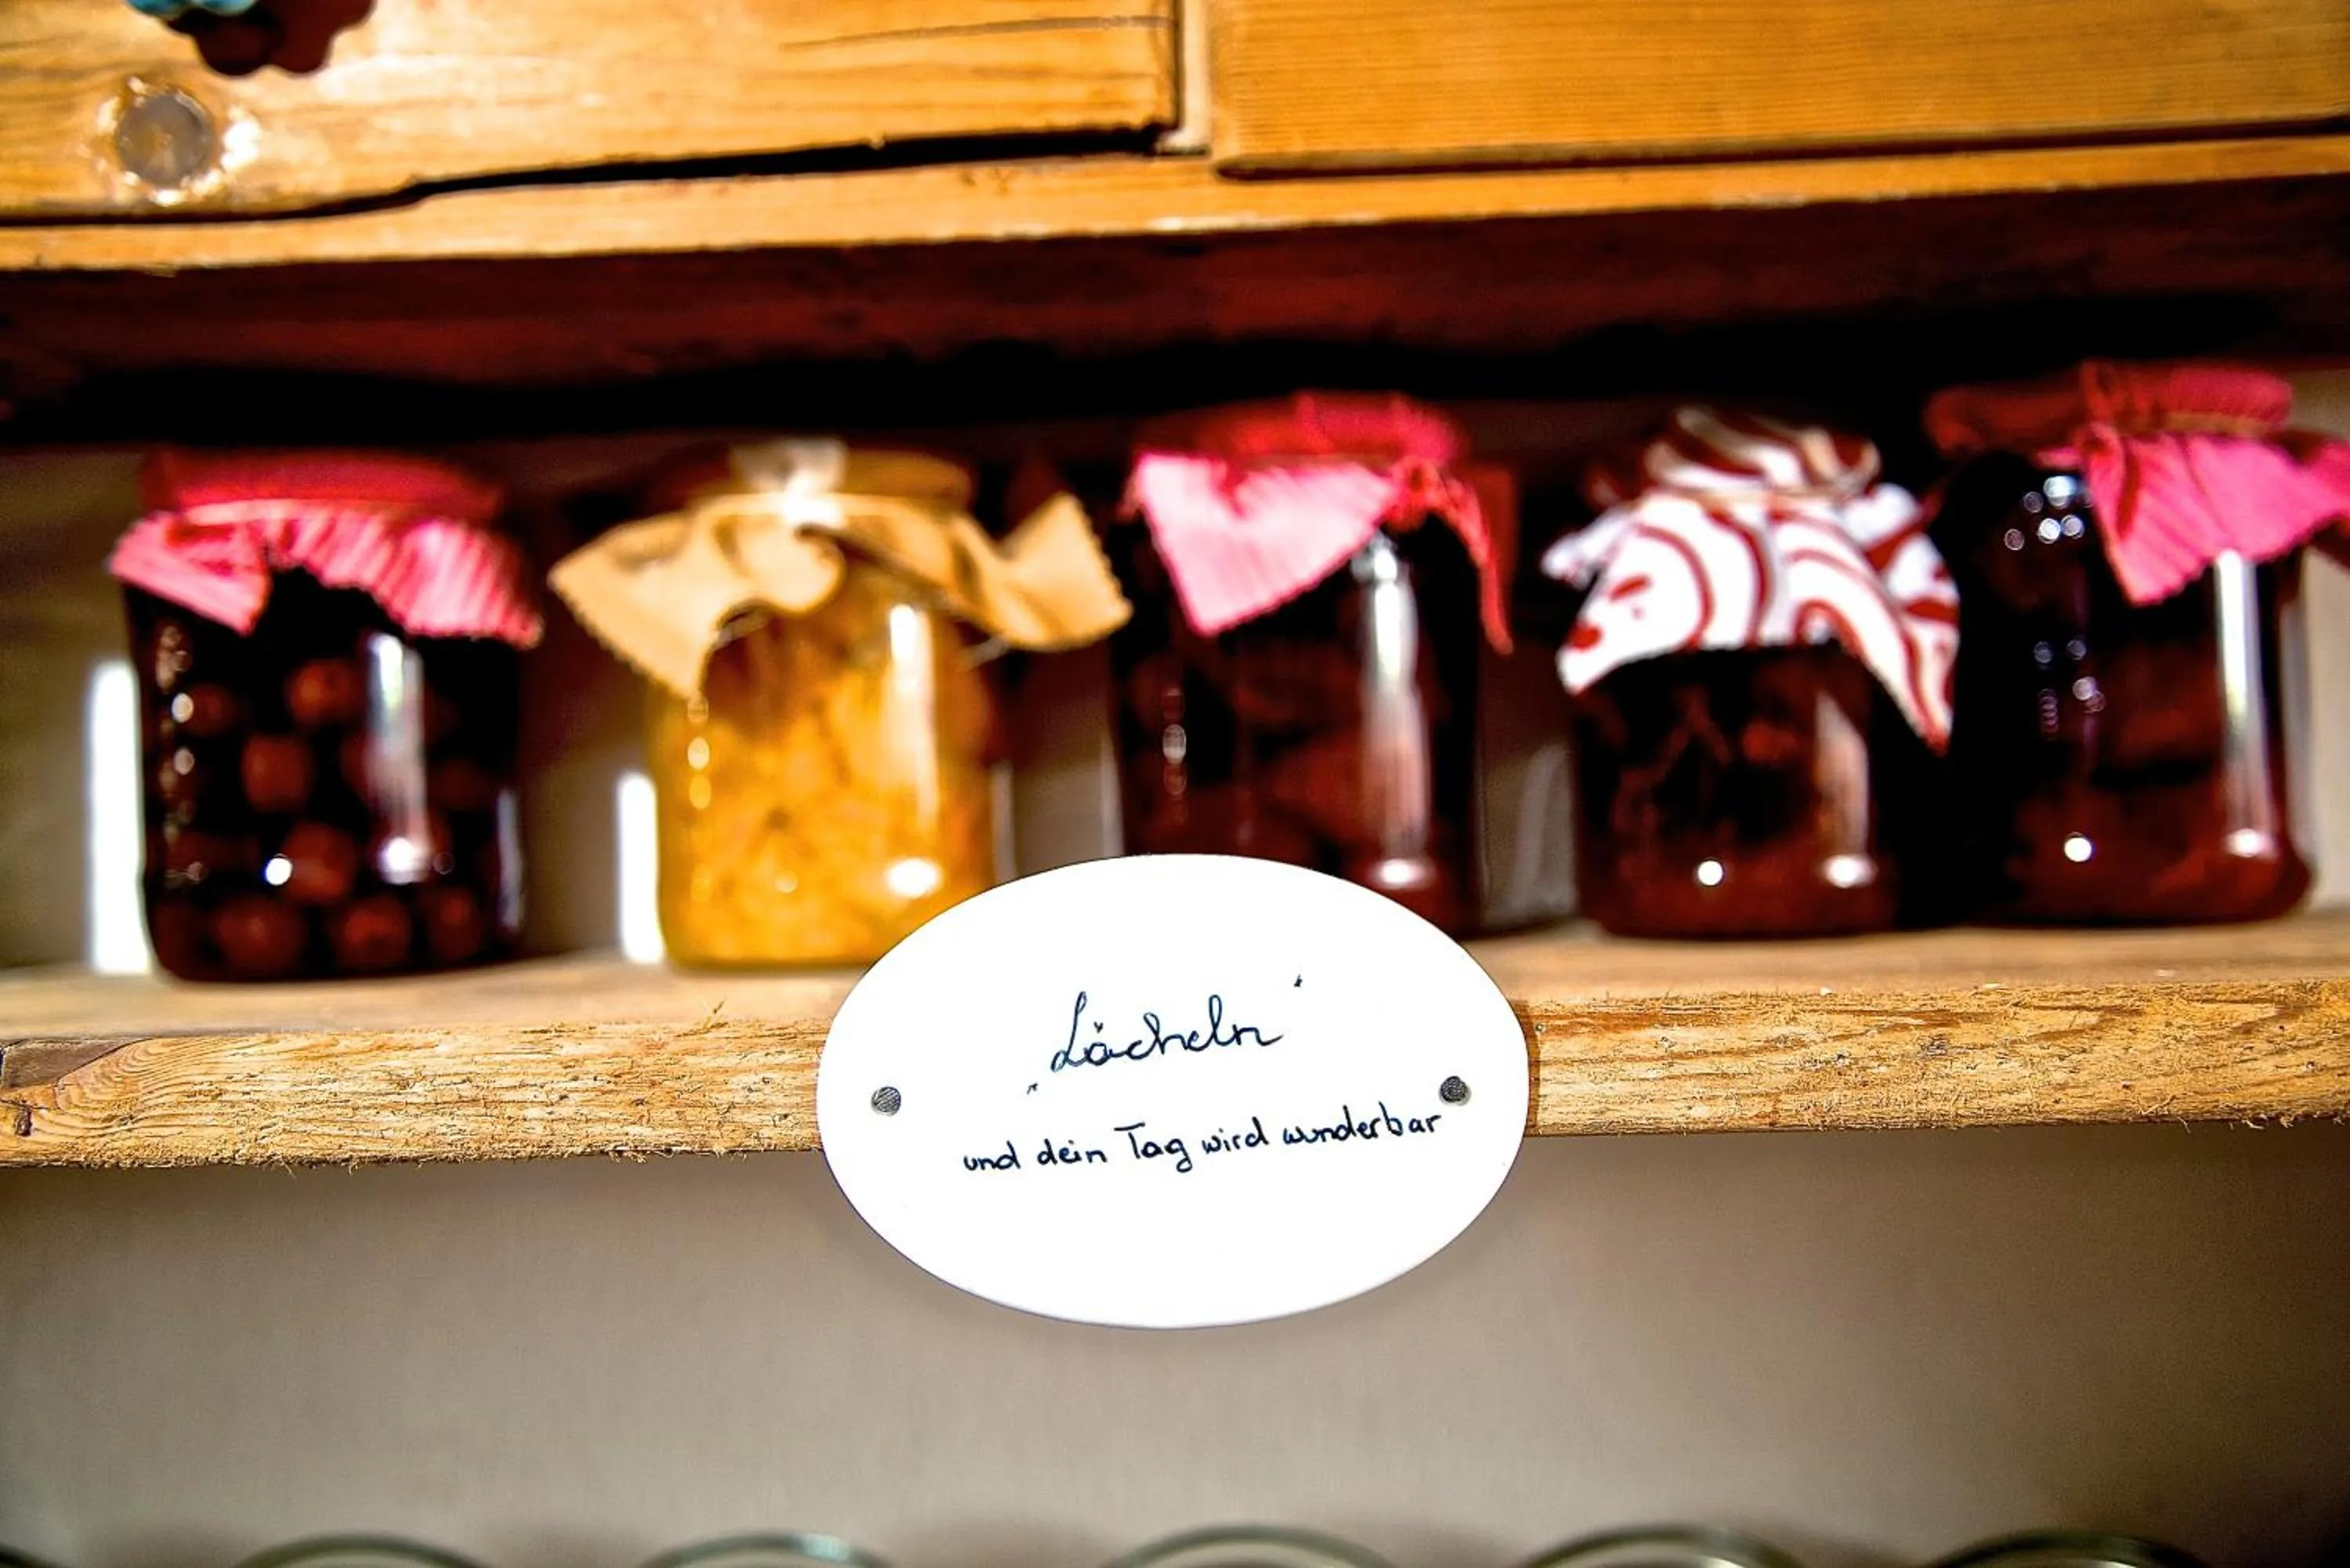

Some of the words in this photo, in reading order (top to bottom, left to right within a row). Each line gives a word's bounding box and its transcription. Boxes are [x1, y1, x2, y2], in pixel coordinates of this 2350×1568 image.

[963, 1140, 1021, 1172] und
[1036, 1137, 1108, 1165] dein
[1113, 1122, 1194, 1174] Tag
[1201, 1116, 1270, 1154] wird
[1282, 1100, 1442, 1146] wunderbar
